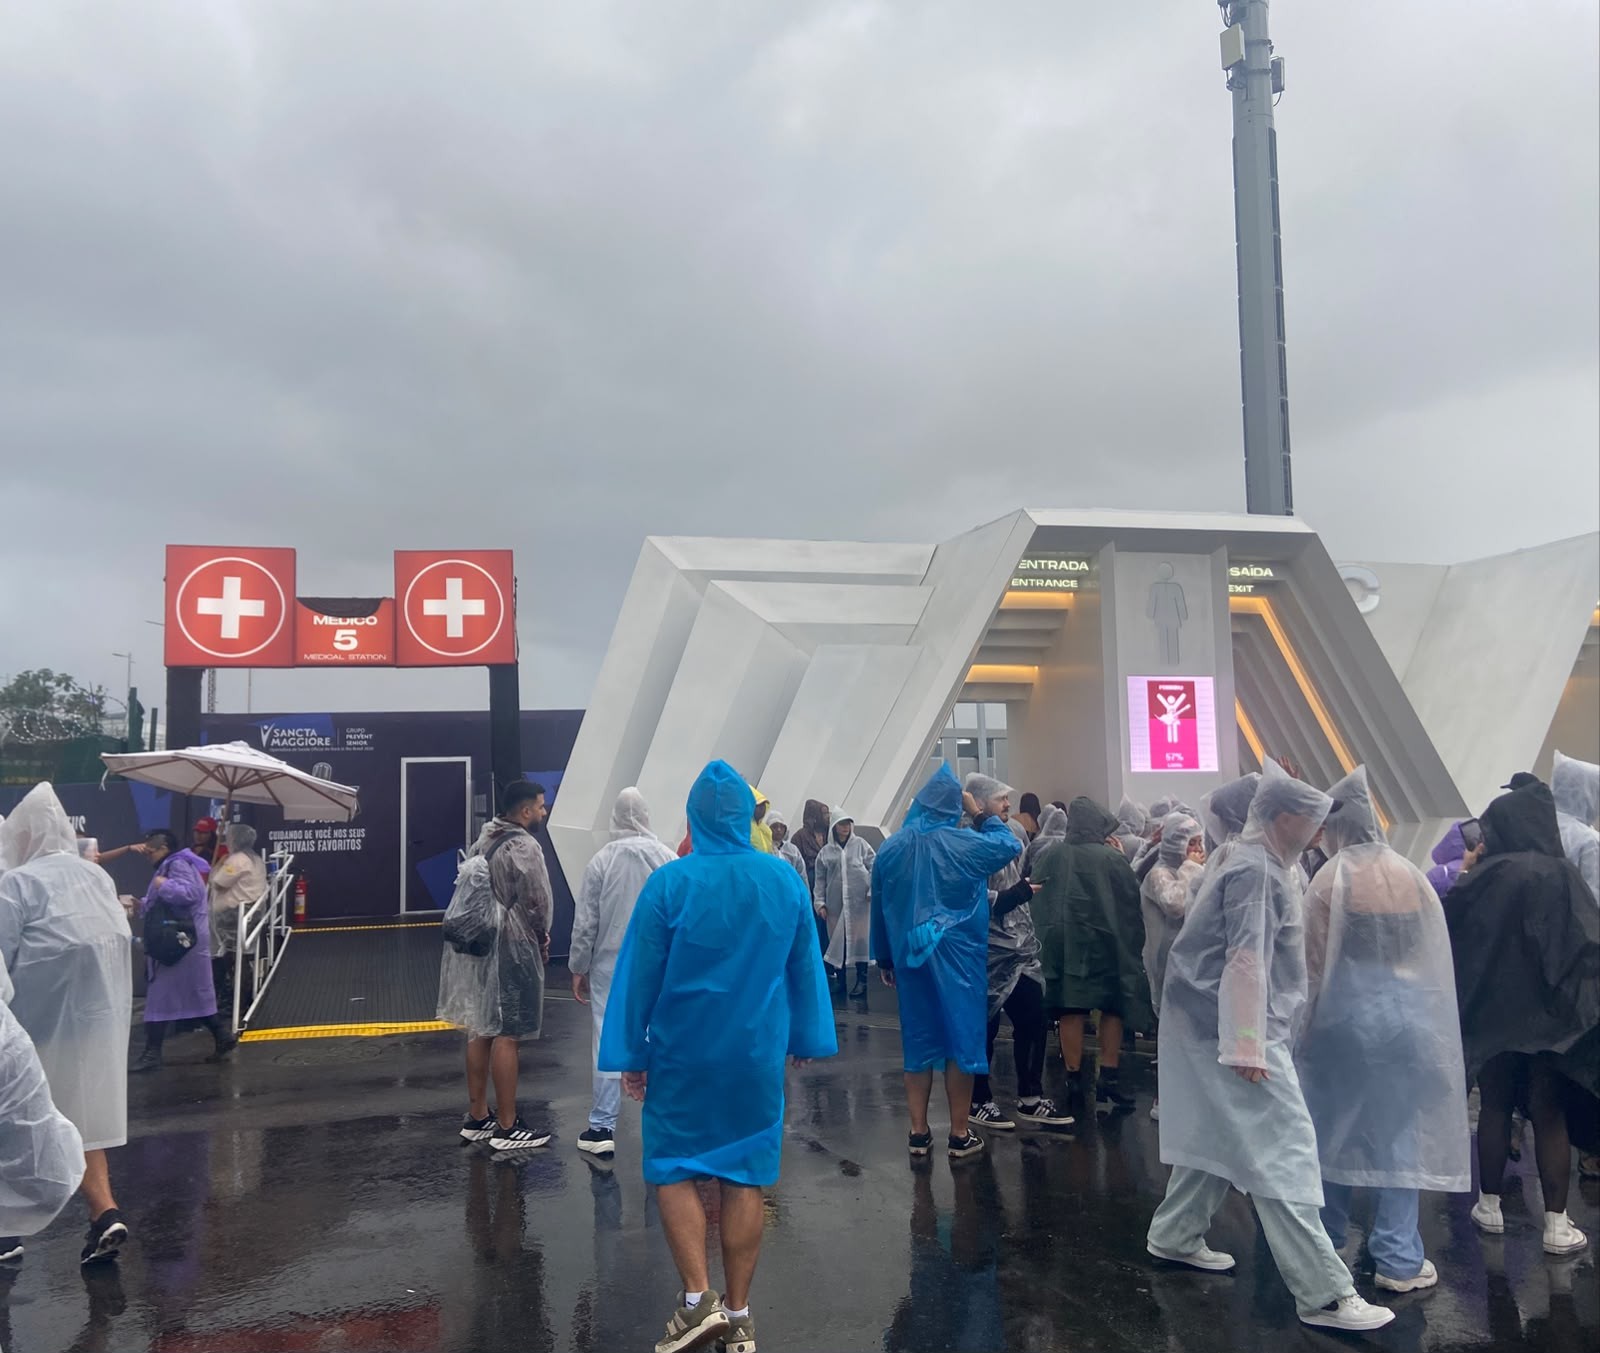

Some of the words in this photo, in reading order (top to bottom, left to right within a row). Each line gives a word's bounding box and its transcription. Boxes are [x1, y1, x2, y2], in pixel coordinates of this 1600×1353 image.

[1018, 559, 1089, 571] ENTRADA
[1229, 564, 1274, 577] SAÍDA
[1011, 578, 1079, 588] ENTRANCE
[1228, 584, 1254, 593] EXIT
[333, 629, 358, 651] 5
[273, 728, 317, 737] SANCTA
[270, 737, 331, 746] MAGGIORE
[268, 830, 302, 840] CUIDANDO
[304, 829, 312, 839] DE
[315, 826, 331, 839] VOCÊ
[333, 829, 347, 838] NOS
[348, 828, 365, 838] SEUS
[317, 839, 362, 851] FAVORITOS
